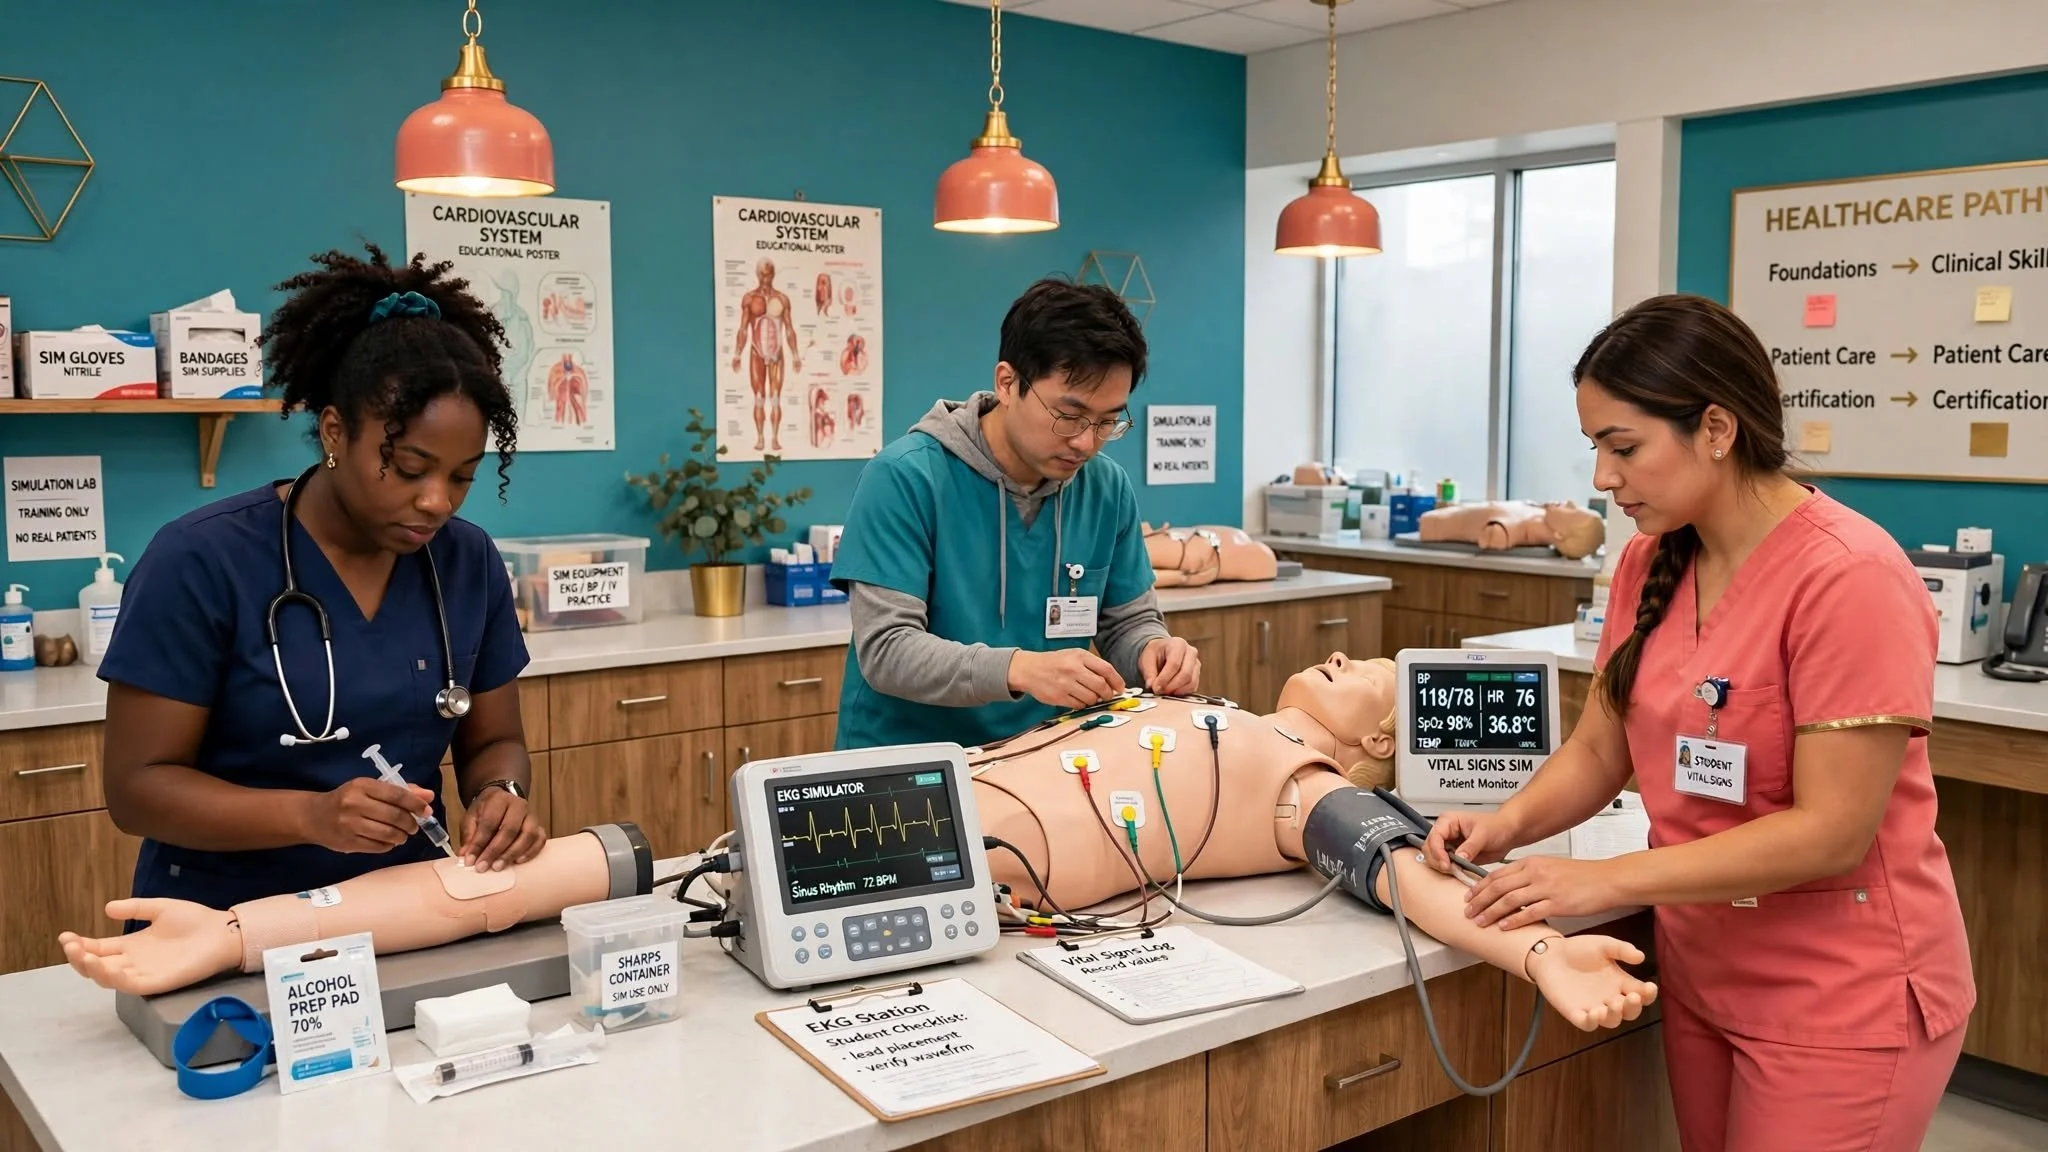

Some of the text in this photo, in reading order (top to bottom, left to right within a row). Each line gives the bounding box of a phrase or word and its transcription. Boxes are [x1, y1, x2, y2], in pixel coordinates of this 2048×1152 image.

[433, 205, 579, 229] CARDIOVASCULAR
[1766, 185, 2048, 232] HEALTHCARE PATH
[739, 208, 860, 229] CARDIOVASCULAR
[480, 228, 542, 245] SYSTEM
[776, 226, 829, 241] SYSTEM
[459, 246, 560, 260] EDUCATIONAL POSTER
[756, 240, 845, 254] EDUCATIONAL POSTER
[1769, 260, 1877, 282] Foundations
[1932, 250, 2002, 273] Clinical
[40, 351, 125, 364] SIM GLOVES
[180, 352, 248, 364] BANDAGES
[1772, 347, 1831, 365] Patient
[1836, 346, 1876, 364] Care
[1933, 344, 2002, 364] Patient
[64, 367, 102, 377] NITRILE
[182, 367, 246, 376] SIM SUPPLIES
[1781, 389, 1875, 408] ertification
[1153, 416, 1211, 427] SIMULATION LAB
[11, 478, 96, 491] SIMULATION LAB
[18, 506, 89, 518] TRAINING ONLY
[15, 530, 97, 543] NO REAL PATIENTS
[553, 567, 624, 580] SIM EQUIPMENT
[560, 583, 577, 593] EKG
[587, 582, 598, 592] BP
[608, 581, 617, 590] IV
[567, 594, 611, 605] PRACTICE
[1417, 673, 1431, 684] BP
[1419, 687, 1535, 709] 118/78 HR 76
[1446, 715, 1473, 731] 98%
[1488, 716, 1536, 734] 36.8°C
[1428, 759, 1533, 772] VITAL SIGNS SIM
[1695, 755, 1733, 771] STUDENT
[1440, 778, 1519, 789] Patient Monitor
[1687, 771, 1733, 787] VITAL SIGNS
[777, 782, 865, 802] EKG SIMULATOR
[792, 874, 897, 898] Sinus Rhythm 72 BPM
[618, 950, 661, 969] SHARPS
[1062, 942, 1175, 966] Vital Signs Log
[1081, 954, 1169, 974] Record values
[609, 963, 670, 985] CONTAINER
[288, 974, 357, 1000] ALCOHOL
[612, 983, 669, 1002] SIM USE ONLY
[289, 991, 360, 1017] PREP PAD
[291, 1016, 322, 1034] 70%
[805, 1003, 930, 1033] EKG Station
[826, 1013, 968, 1047] Student Checklist:
[849, 1030, 962, 1060] lead placement
[866, 1056, 908, 1072] verify
